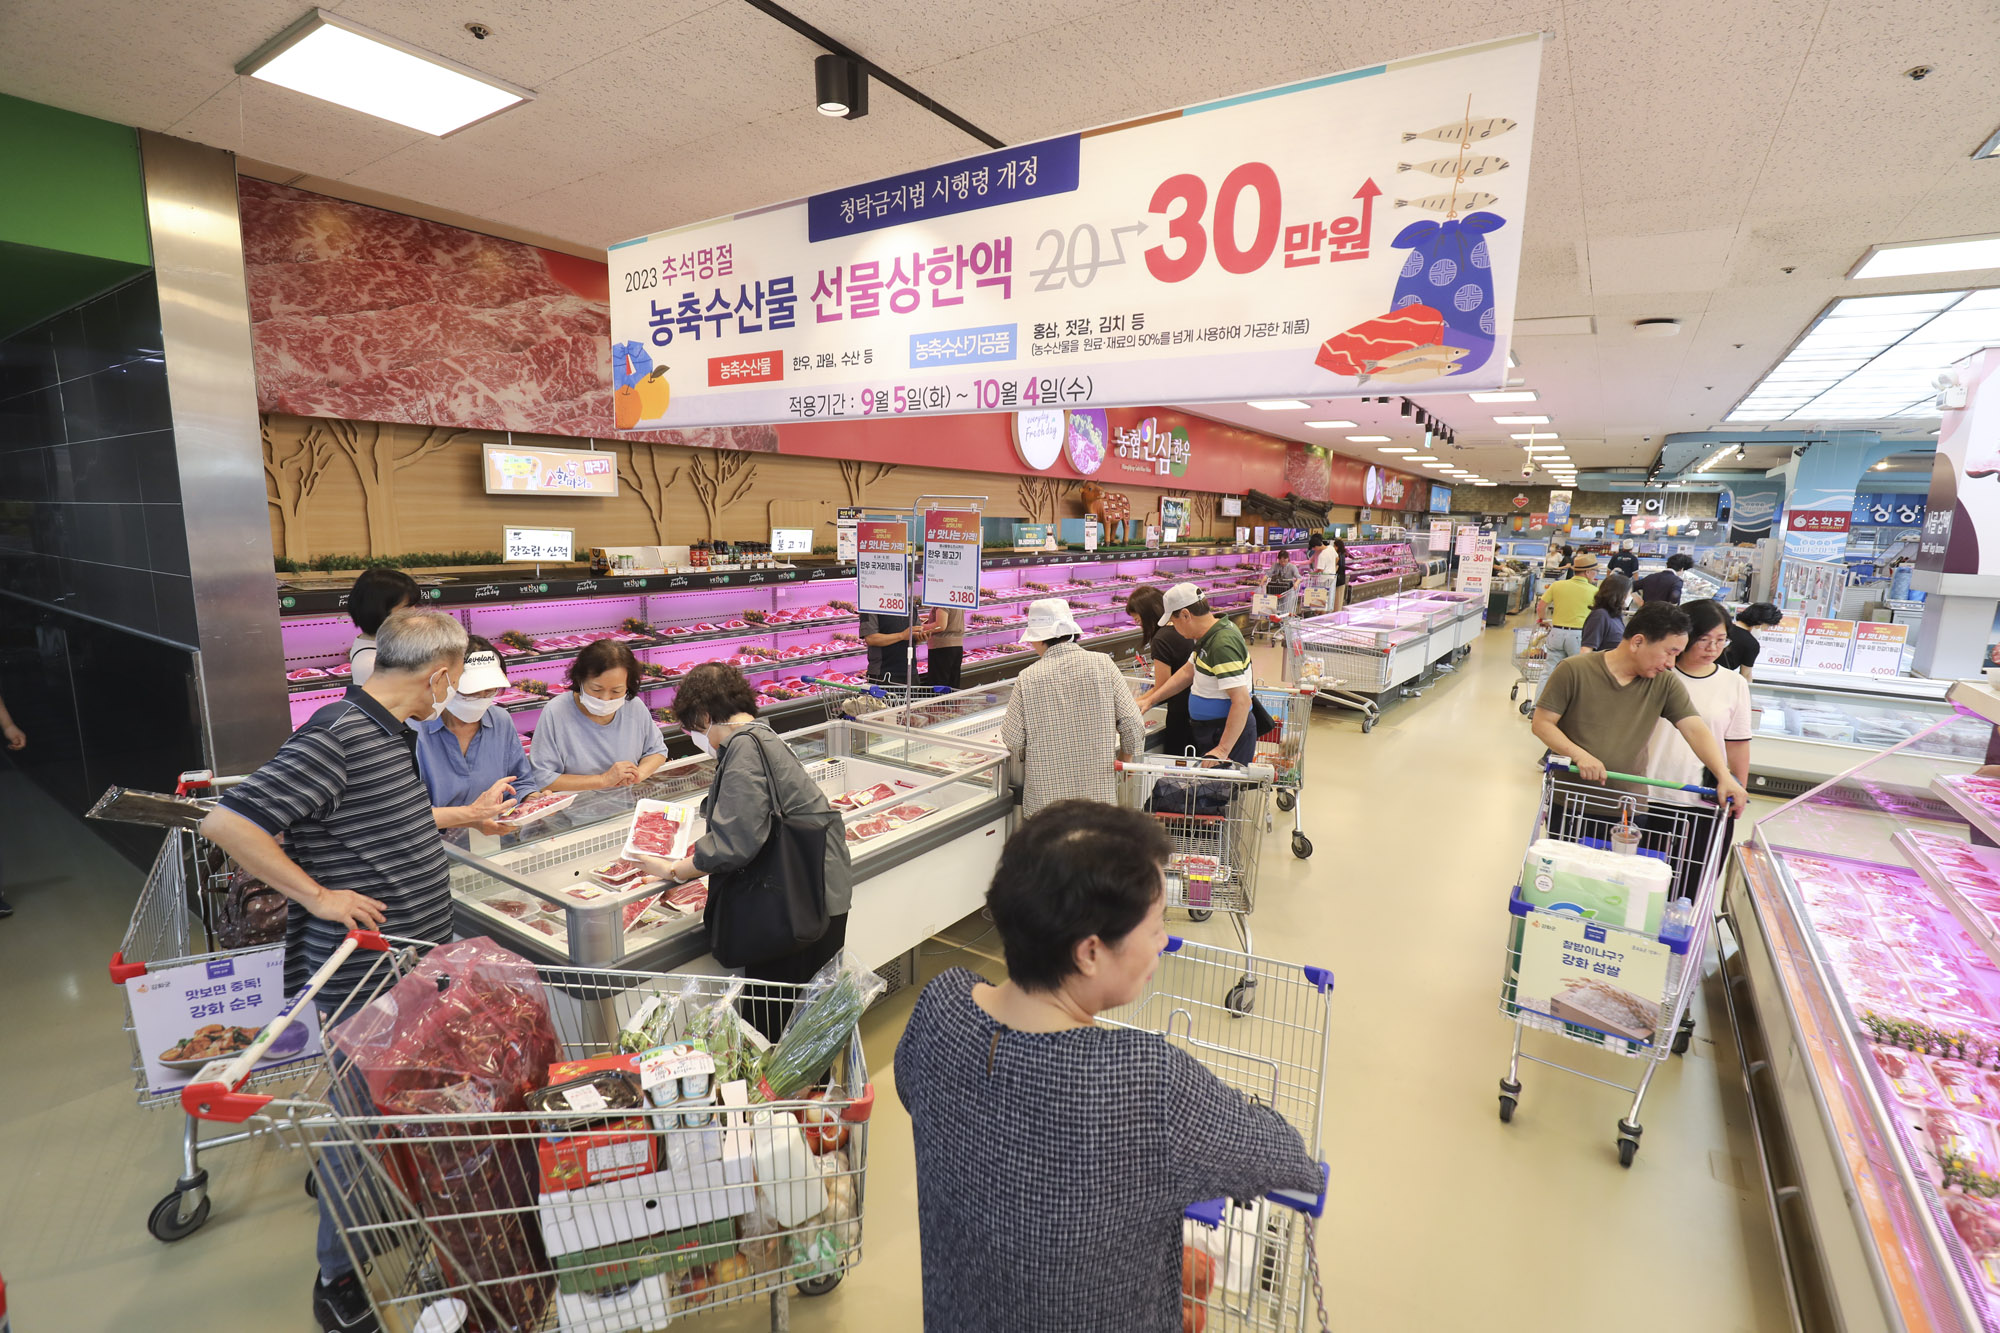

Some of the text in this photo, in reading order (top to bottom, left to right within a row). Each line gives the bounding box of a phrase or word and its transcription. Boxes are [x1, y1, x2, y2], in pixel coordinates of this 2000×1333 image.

[839, 155, 1039, 225] 청탁금지법 시행령 개정
[625, 243, 734, 294] 2023 추석명절
[648, 275, 798, 348] 농축수산물
[809, 235, 1013, 325] 선물상한액
[1033, 223, 1102, 292] 20
[1031, 339, 1080, 358] (농수산물을
[1137, 330, 1171, 347] 50%를
[1172, 328, 1194, 345] 넘게
[1195, 323, 1241, 343] 사용하여
[1243, 321, 1279, 339] 가공한
[1282, 318, 1310, 336] 제품)
[1033, 313, 1145, 340] 홍삼, 젓갈, 김치 등
[915, 332, 1010, 362] 농축수산가공품
[720, 357, 772, 380] 농축수산물
[792, 349, 873, 372] 한우, 과일, 수산 등
[861, 387, 890, 417] 9월
[893, 382, 951, 416] 5일(화)
[973, 378, 1018, 409] 10월
[1023, 375, 1093, 407] 4일(수)
[1808, 516, 1845, 527] 소화전
[879, 597, 904, 610] 2,880
[949, 590, 975, 604] 3,180
[1768, 656, 1791, 665] 4,980
[1818, 662, 1843, 670] 6,000
[1870, 667, 1896, 675] 6,000
[1562, 940, 1625, 963] 찰밥이냐구?
[1562, 953, 1621, 978] 강화 섬쌀
[185, 977, 262, 1001] 맛보면 중독!
[189, 993, 263, 1019] 강화 순무
